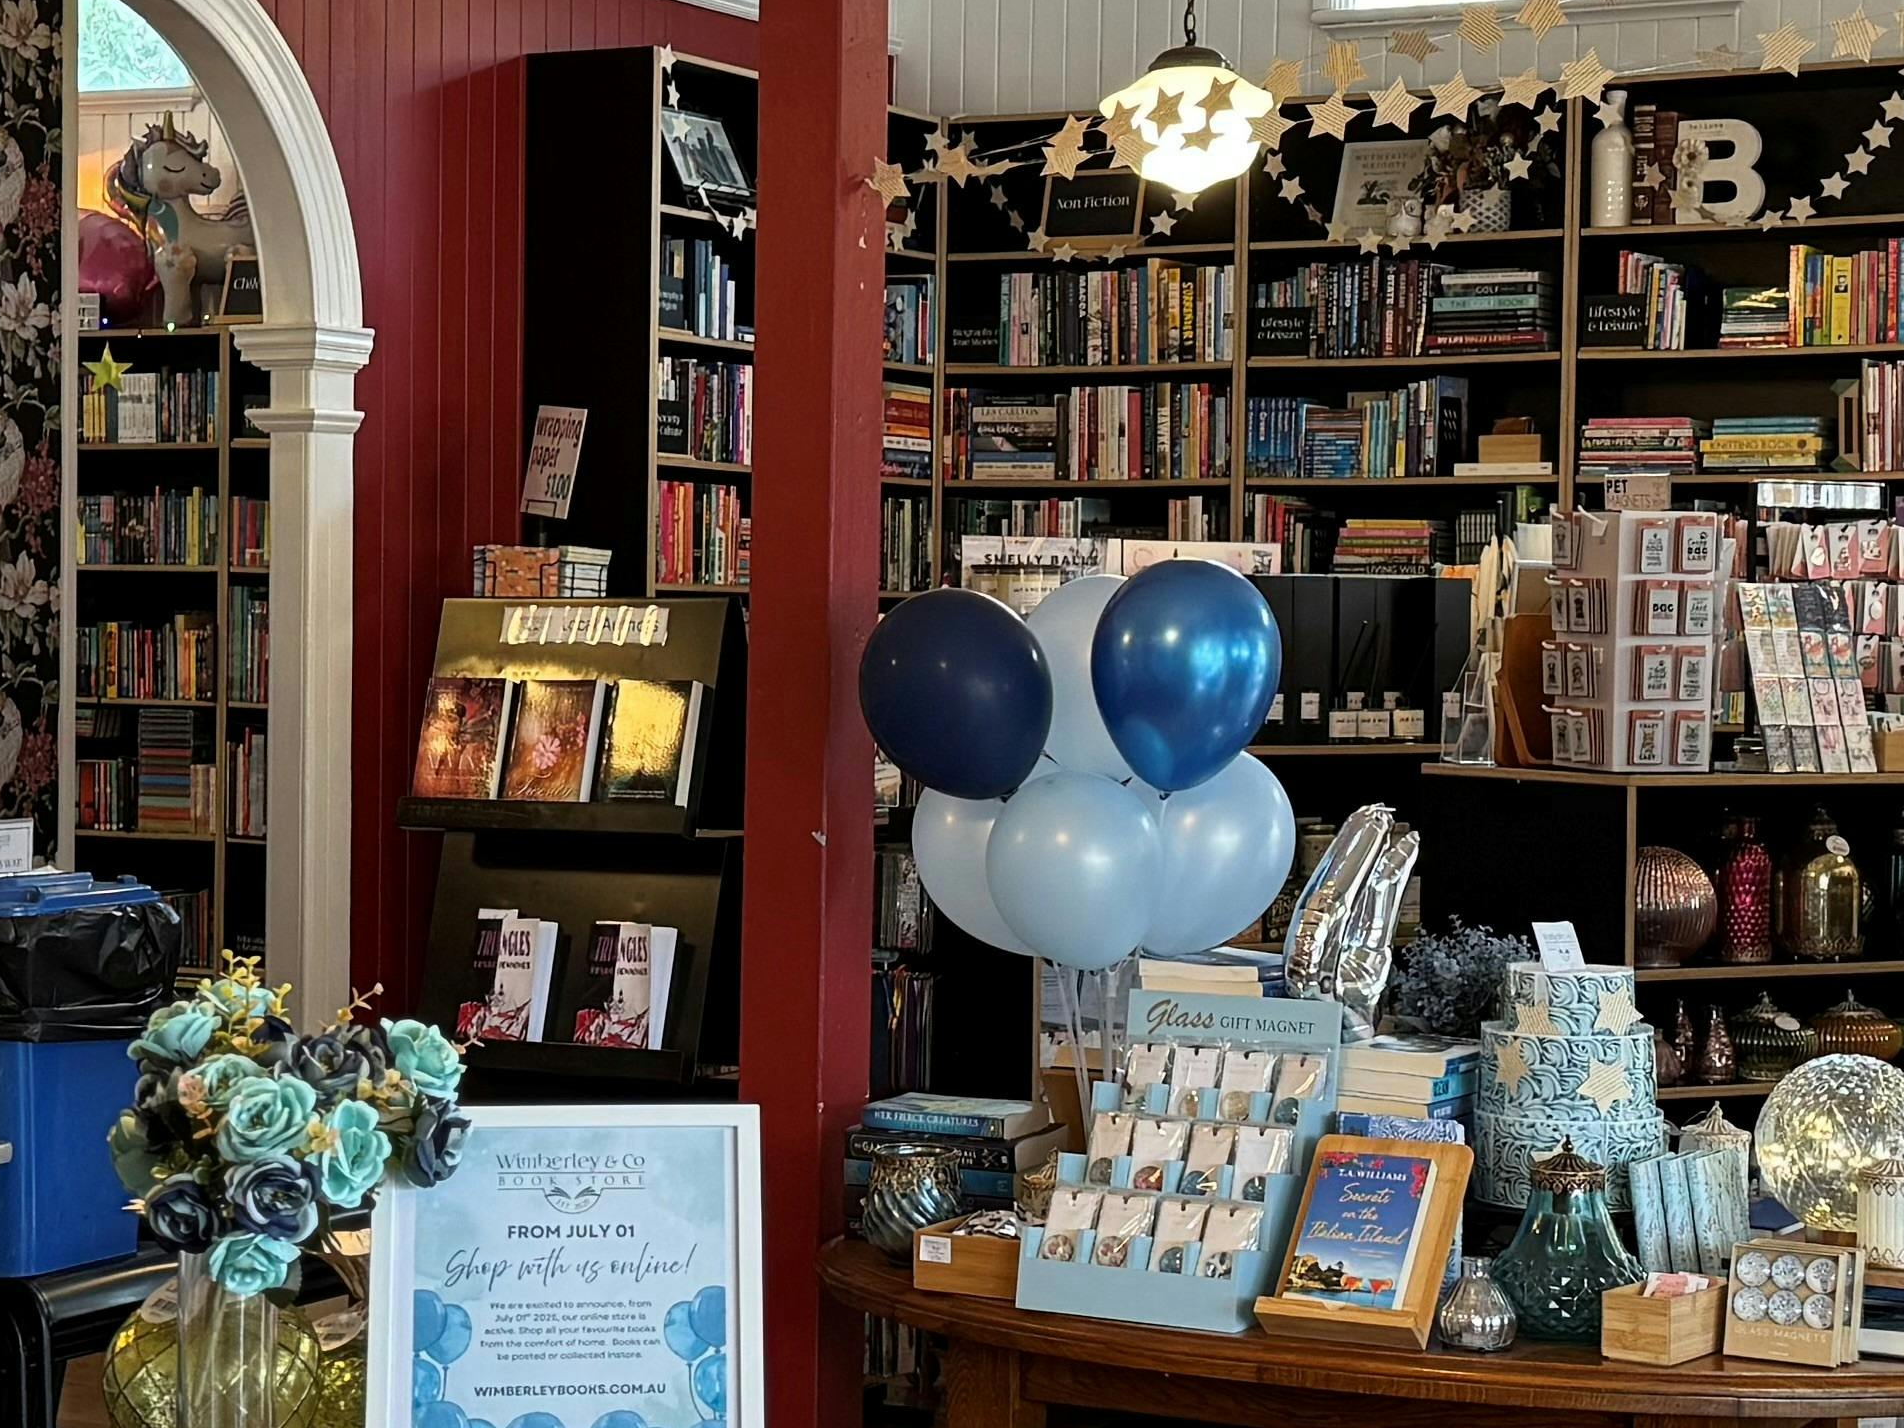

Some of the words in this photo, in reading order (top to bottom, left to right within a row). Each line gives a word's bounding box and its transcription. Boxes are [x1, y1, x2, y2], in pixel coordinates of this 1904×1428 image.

[1677, 119, 1767, 225] B
[1084, 194, 1130, 208] Fiction
[1588, 306, 1641, 320] Lifestyle
[1261, 318, 1305, 329] Lifestyle
[536, 412, 583, 448] wrapping
[530, 445, 560, 474] paper
[545, 474, 572, 500] $1.00
[1606, 479, 1628, 493] PET
[1607, 494, 1652, 509] MAGNETS
[1147, 999, 1215, 1034] Glass
[1220, 1016, 1250, 1030] GIFT
[1256, 1018, 1316, 1035] MAGNET
[926, 1115, 979, 1127] CREATURES
[496, 1153, 599, 1172] Wimberley
[605, 1156, 617, 1169] &
[622, 1153, 645, 1169] Co
[1339, 1183, 1395, 1203] Secrets
[508, 1224, 561, 1239] FROM
[566, 1224, 610, 1239] JULY
[616, 1224, 635, 1238] 01
[1306, 1221, 1354, 1240] Italian
[1355, 1224, 1408, 1244] Island
[445, 1247, 512, 1292] Shop
[517, 1245, 571, 1287] with
[576, 1260, 604, 1284] us
[610, 1243, 696, 1285] online!
[1772, 1329, 1827, 1345] MAGNETS
[474, 1383, 667, 1397] WIMBERLEYBOOKS.COM.AU
